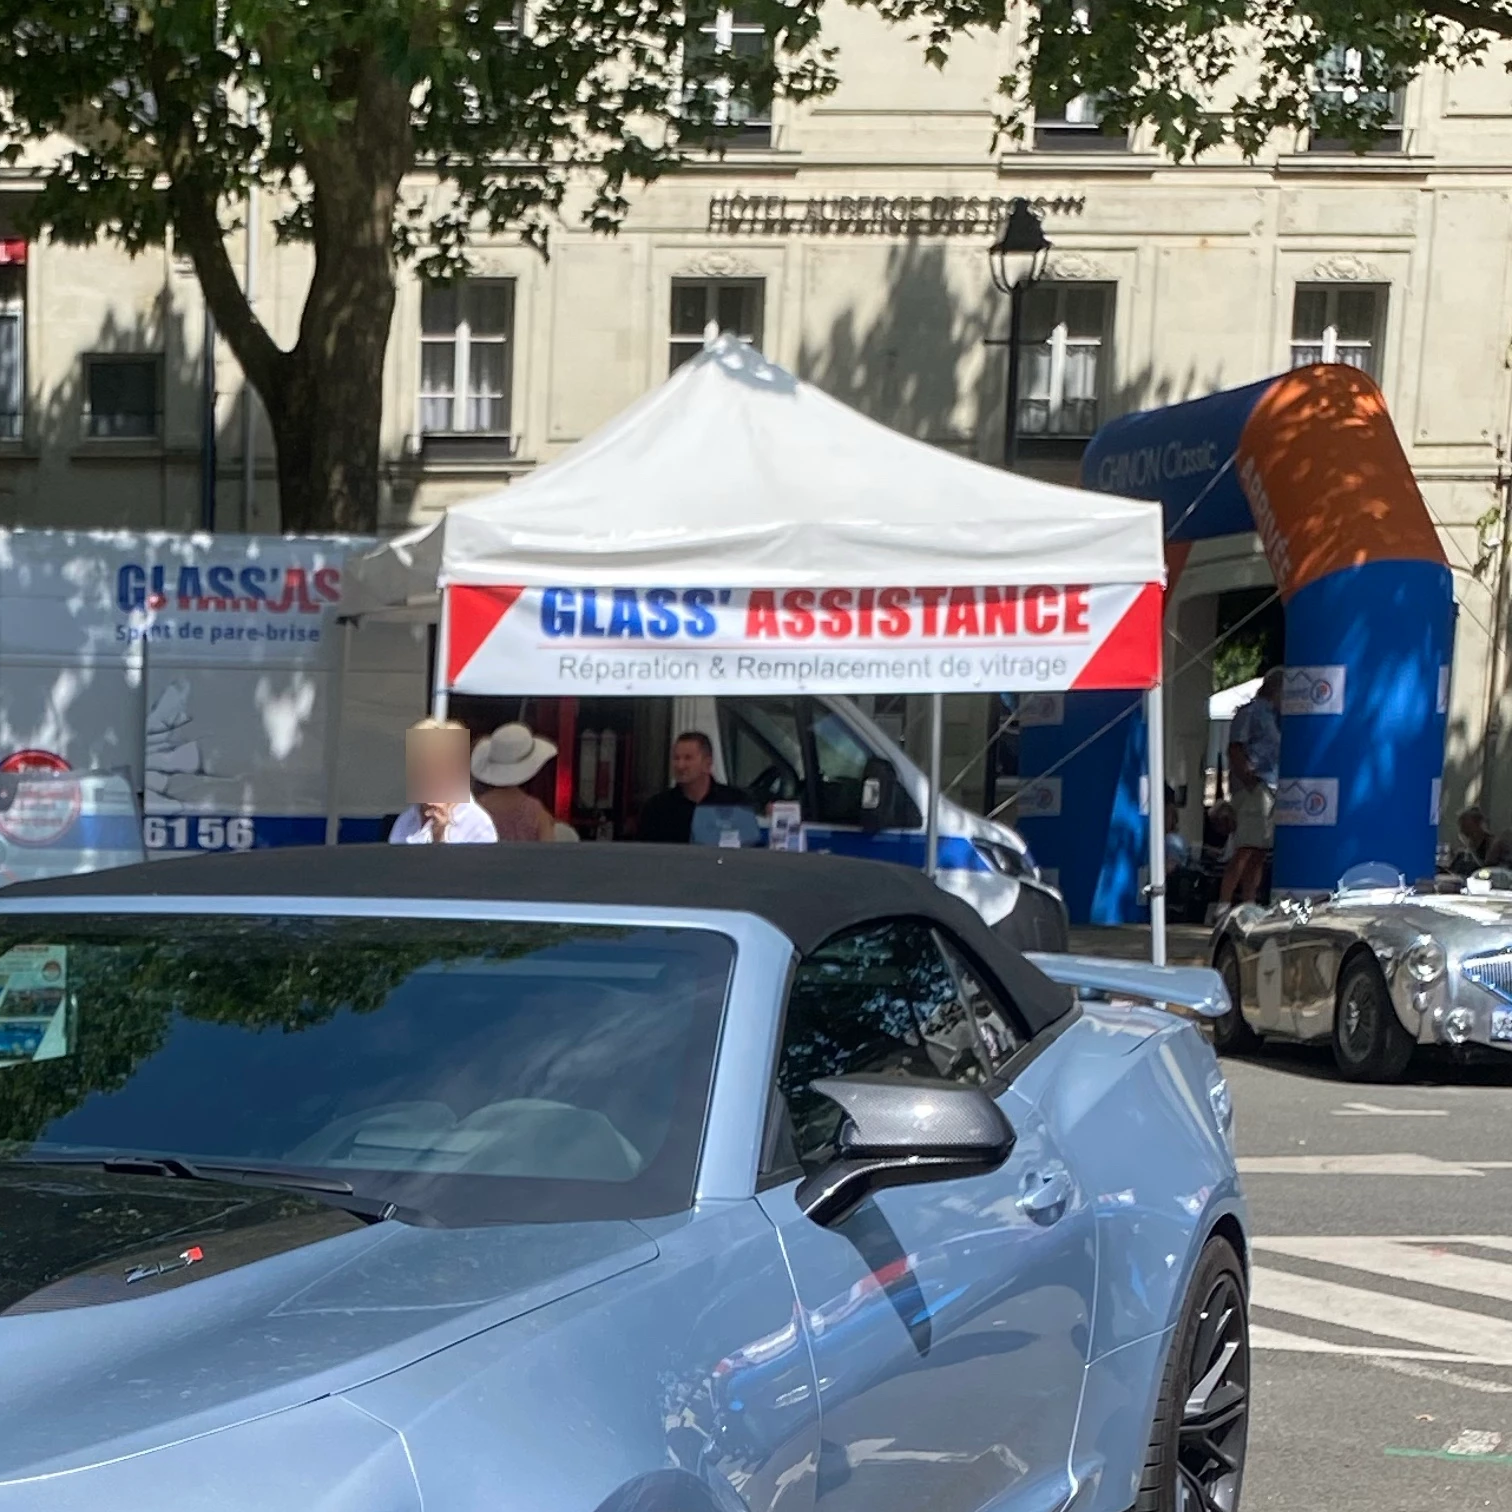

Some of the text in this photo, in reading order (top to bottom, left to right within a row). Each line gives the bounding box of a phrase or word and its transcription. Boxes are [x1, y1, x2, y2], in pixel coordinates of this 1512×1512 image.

[540, 584, 1091, 639] GLASS' ASSISTANCE
[178, 621, 205, 640] de
[210, 622, 321, 645] pare-brise
[559, 653, 1067, 684] Réparation & Remplacement de vitrage
[144, 817, 254, 850] 61 56
